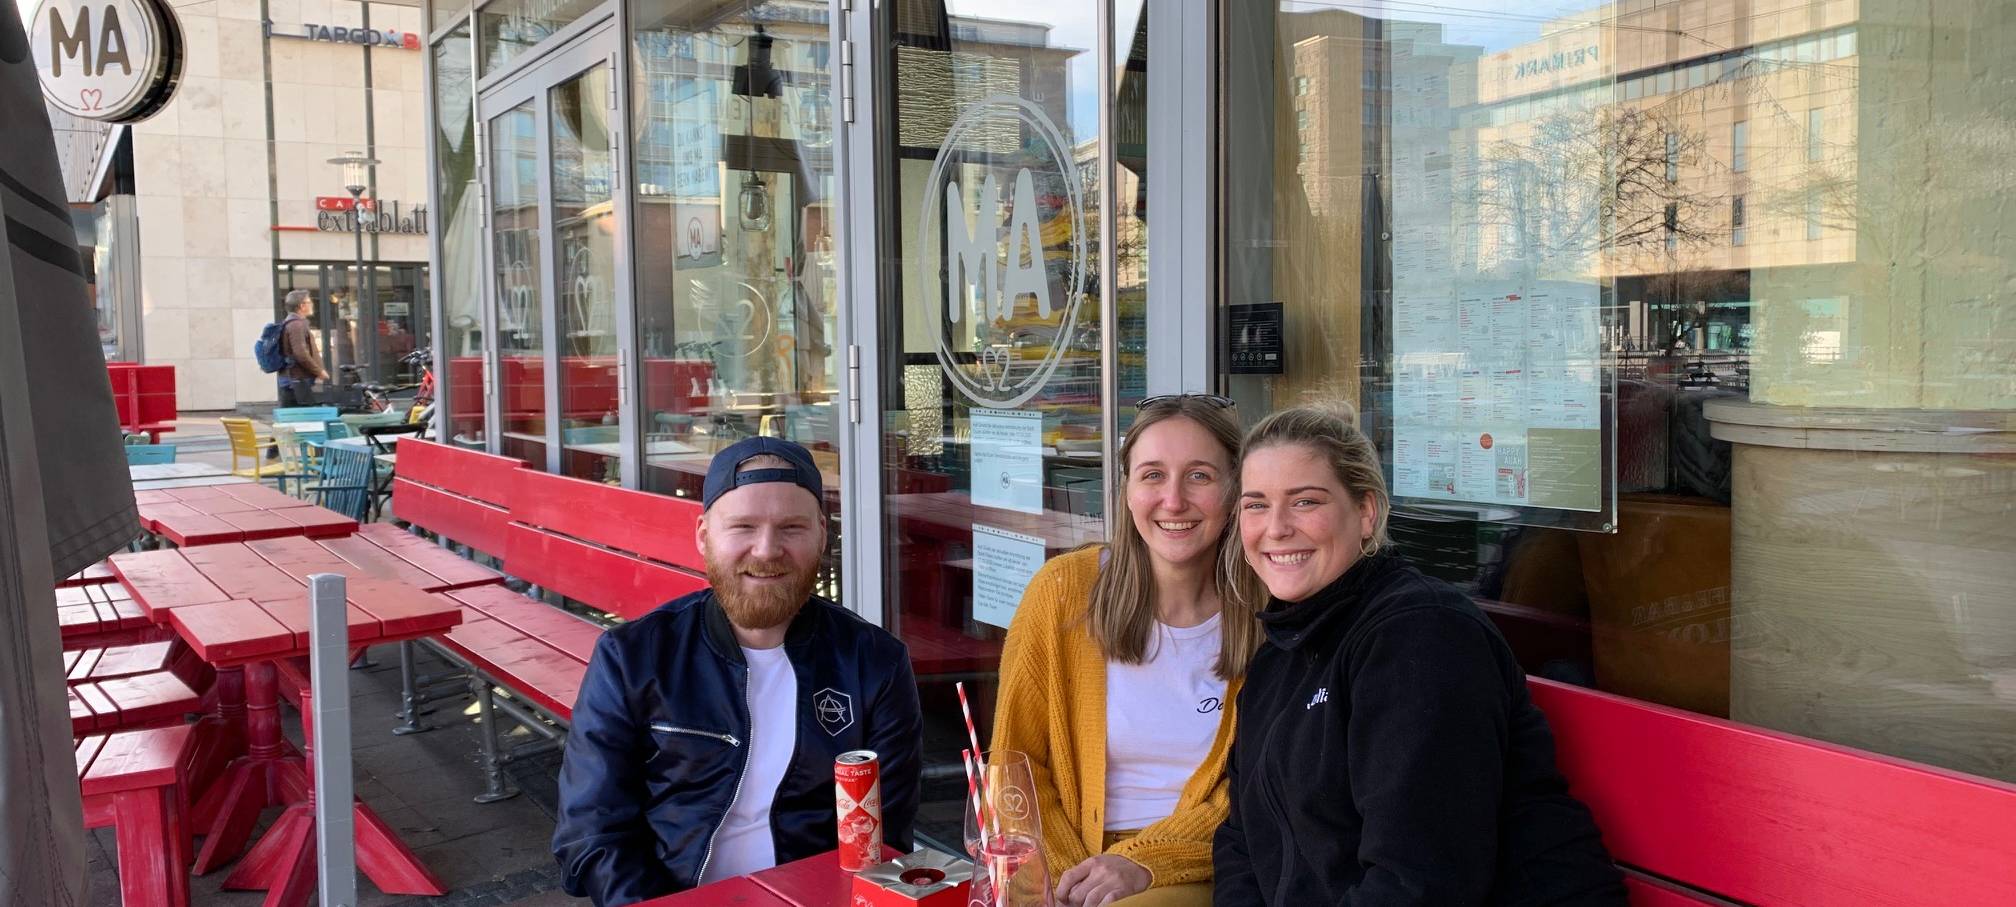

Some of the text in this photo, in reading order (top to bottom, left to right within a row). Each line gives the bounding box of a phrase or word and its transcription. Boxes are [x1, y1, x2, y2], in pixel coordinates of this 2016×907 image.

[49, 5, 131, 78] MA
[318, 199, 428, 233] extablatt
[319, 199, 373, 209] CAE
[946, 167, 1051, 324] MA
[850, 768, 872, 777] TASTE
